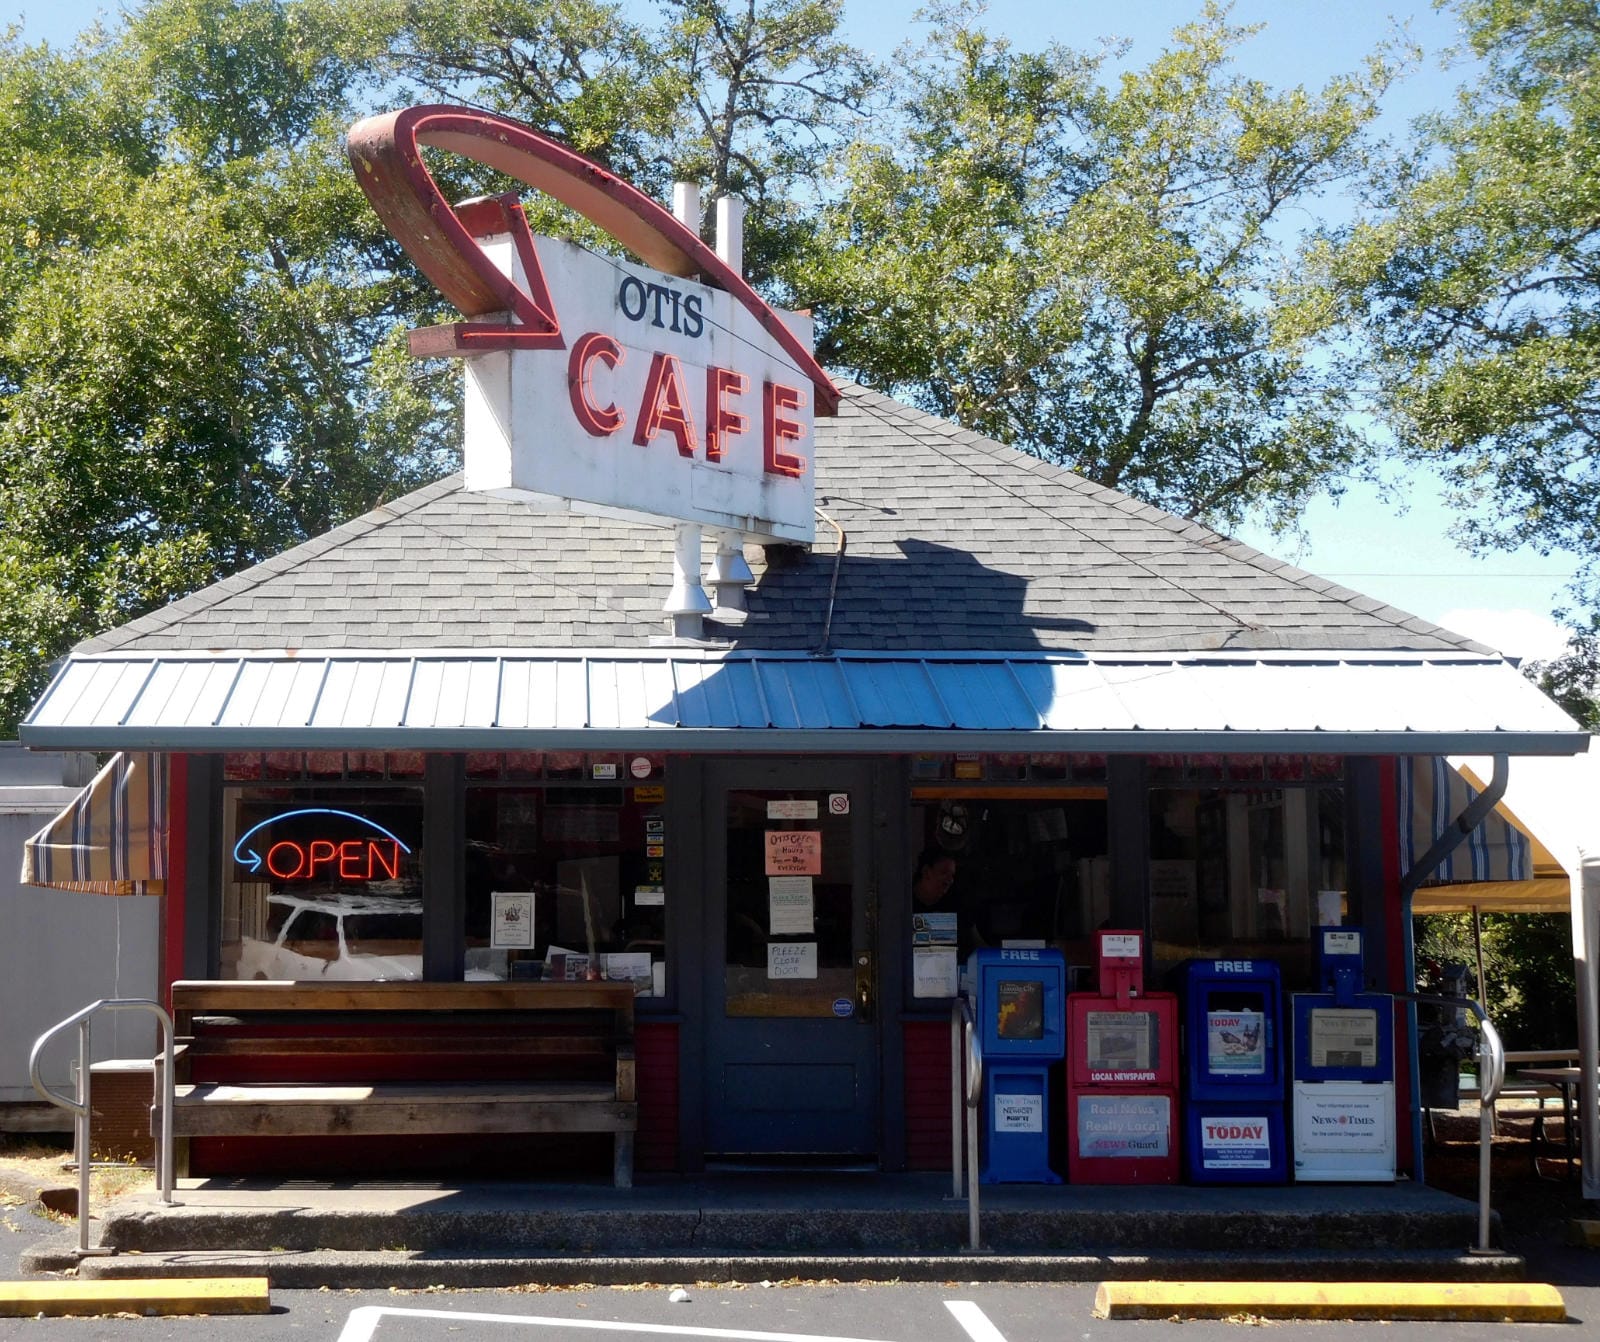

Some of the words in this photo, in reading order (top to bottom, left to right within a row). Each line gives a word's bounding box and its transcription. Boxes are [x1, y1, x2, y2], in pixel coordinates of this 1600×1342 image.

[619, 276, 704, 338] OTIS
[568, 332, 807, 478] CAFE
[267, 841, 398, 879] OPEN
[1000, 950, 1040, 961] FREE
[1214, 960, 1253, 973] FREE
[1091, 1072, 1113, 1081] LOCAL
[1114, 1072, 1156, 1081] NEWSPAPER
[1091, 1104, 1117, 1114] Real
[1086, 1120, 1125, 1132] Really
[1127, 1120, 1160, 1131] Local
[1311, 1115, 1337, 1125] NEWS
[1347, 1115, 1376, 1125] TIMES
[1206, 1126, 1263, 1139] TODAY
[1128, 1140, 1159, 1149] Guard
